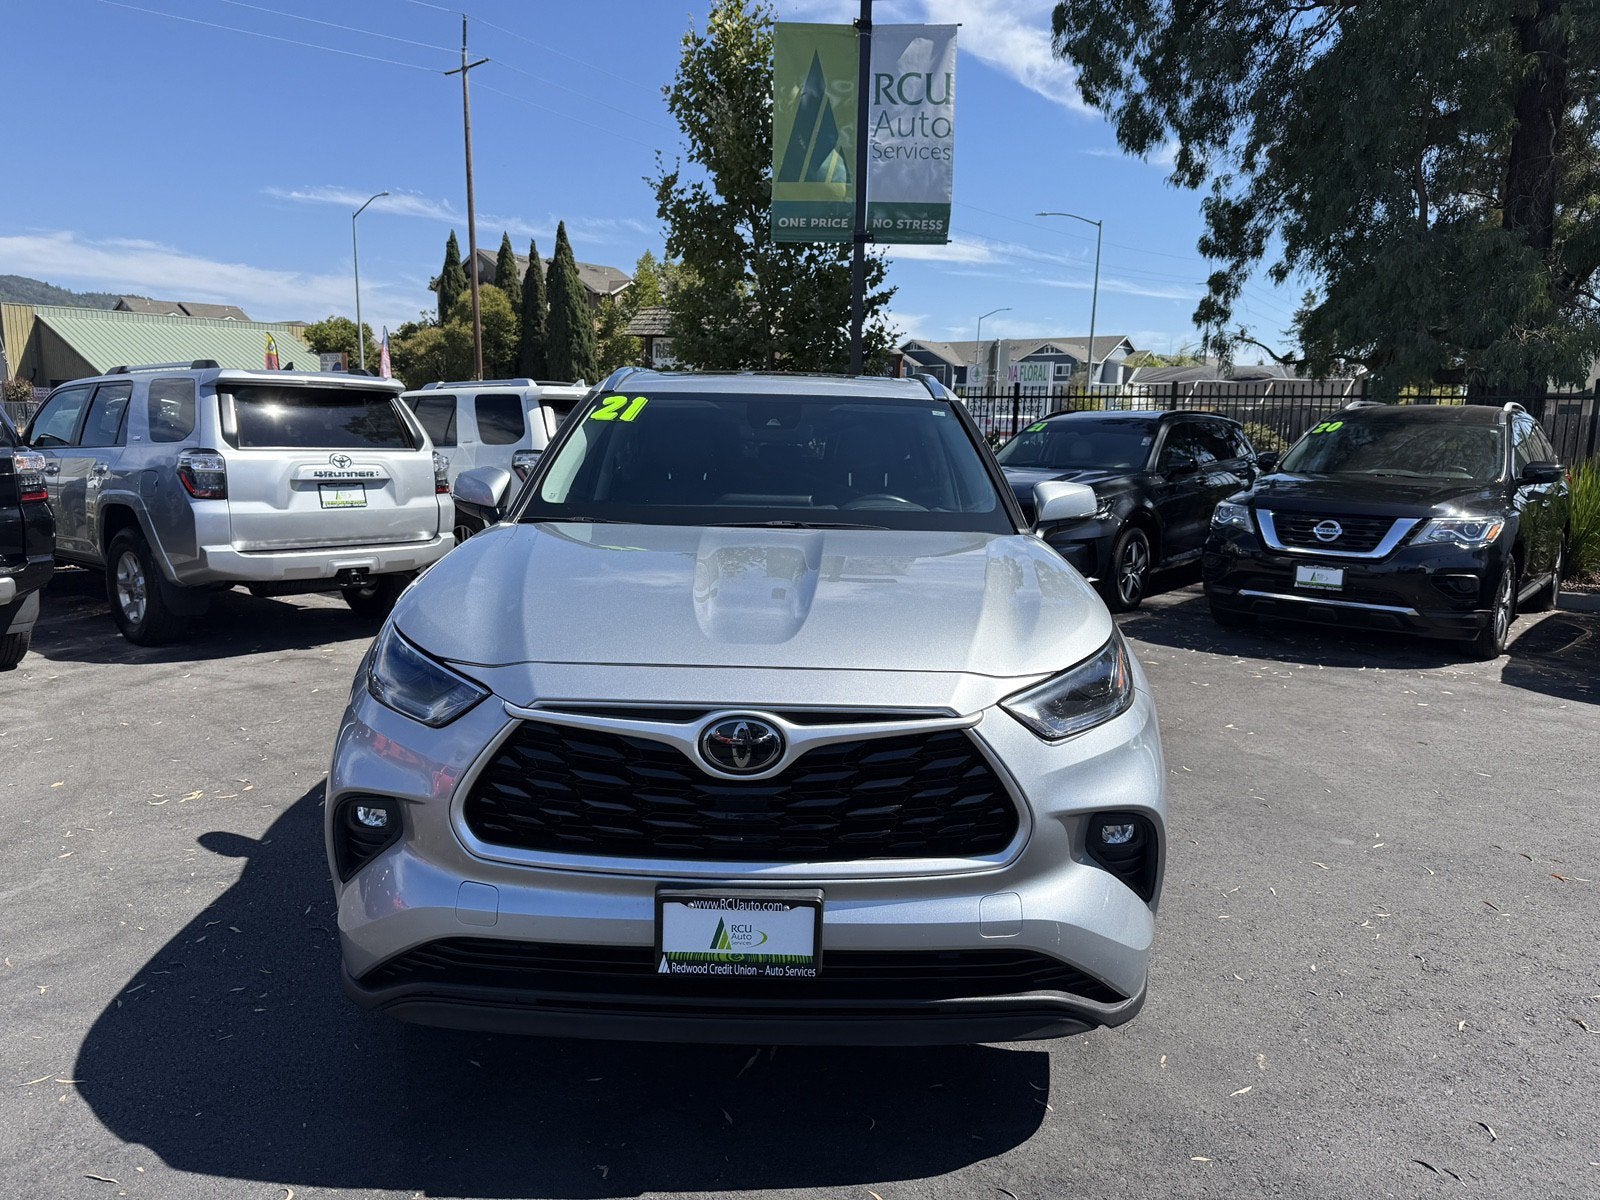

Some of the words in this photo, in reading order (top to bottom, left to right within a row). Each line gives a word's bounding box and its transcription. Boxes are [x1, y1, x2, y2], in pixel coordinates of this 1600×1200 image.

[873, 72, 951, 106] RCU
[873, 109, 951, 138] Auto
[872, 142, 951, 161] Services
[778, 217, 807, 228] ONE
[811, 217, 849, 228] PRICE
[873, 218, 893, 229] NO
[896, 219, 944, 230] STRESS
[1020, 364, 1047, 381] FLORAL
[590, 395, 649, 422] 21
[1026, 422, 1048, 432] 21
[1311, 421, 1344, 434] 20
[693, 898, 784, 912] www.RCUauto.com
[731, 924, 752, 934] RCU
[731, 933, 752, 941] Auto
[671, 962, 708, 974] Redwood
[709, 963, 733, 975] Credit
[734, 964, 757, 976] Union
[765, 965, 784, 976] Auto
[785, 966, 816, 977] Services
